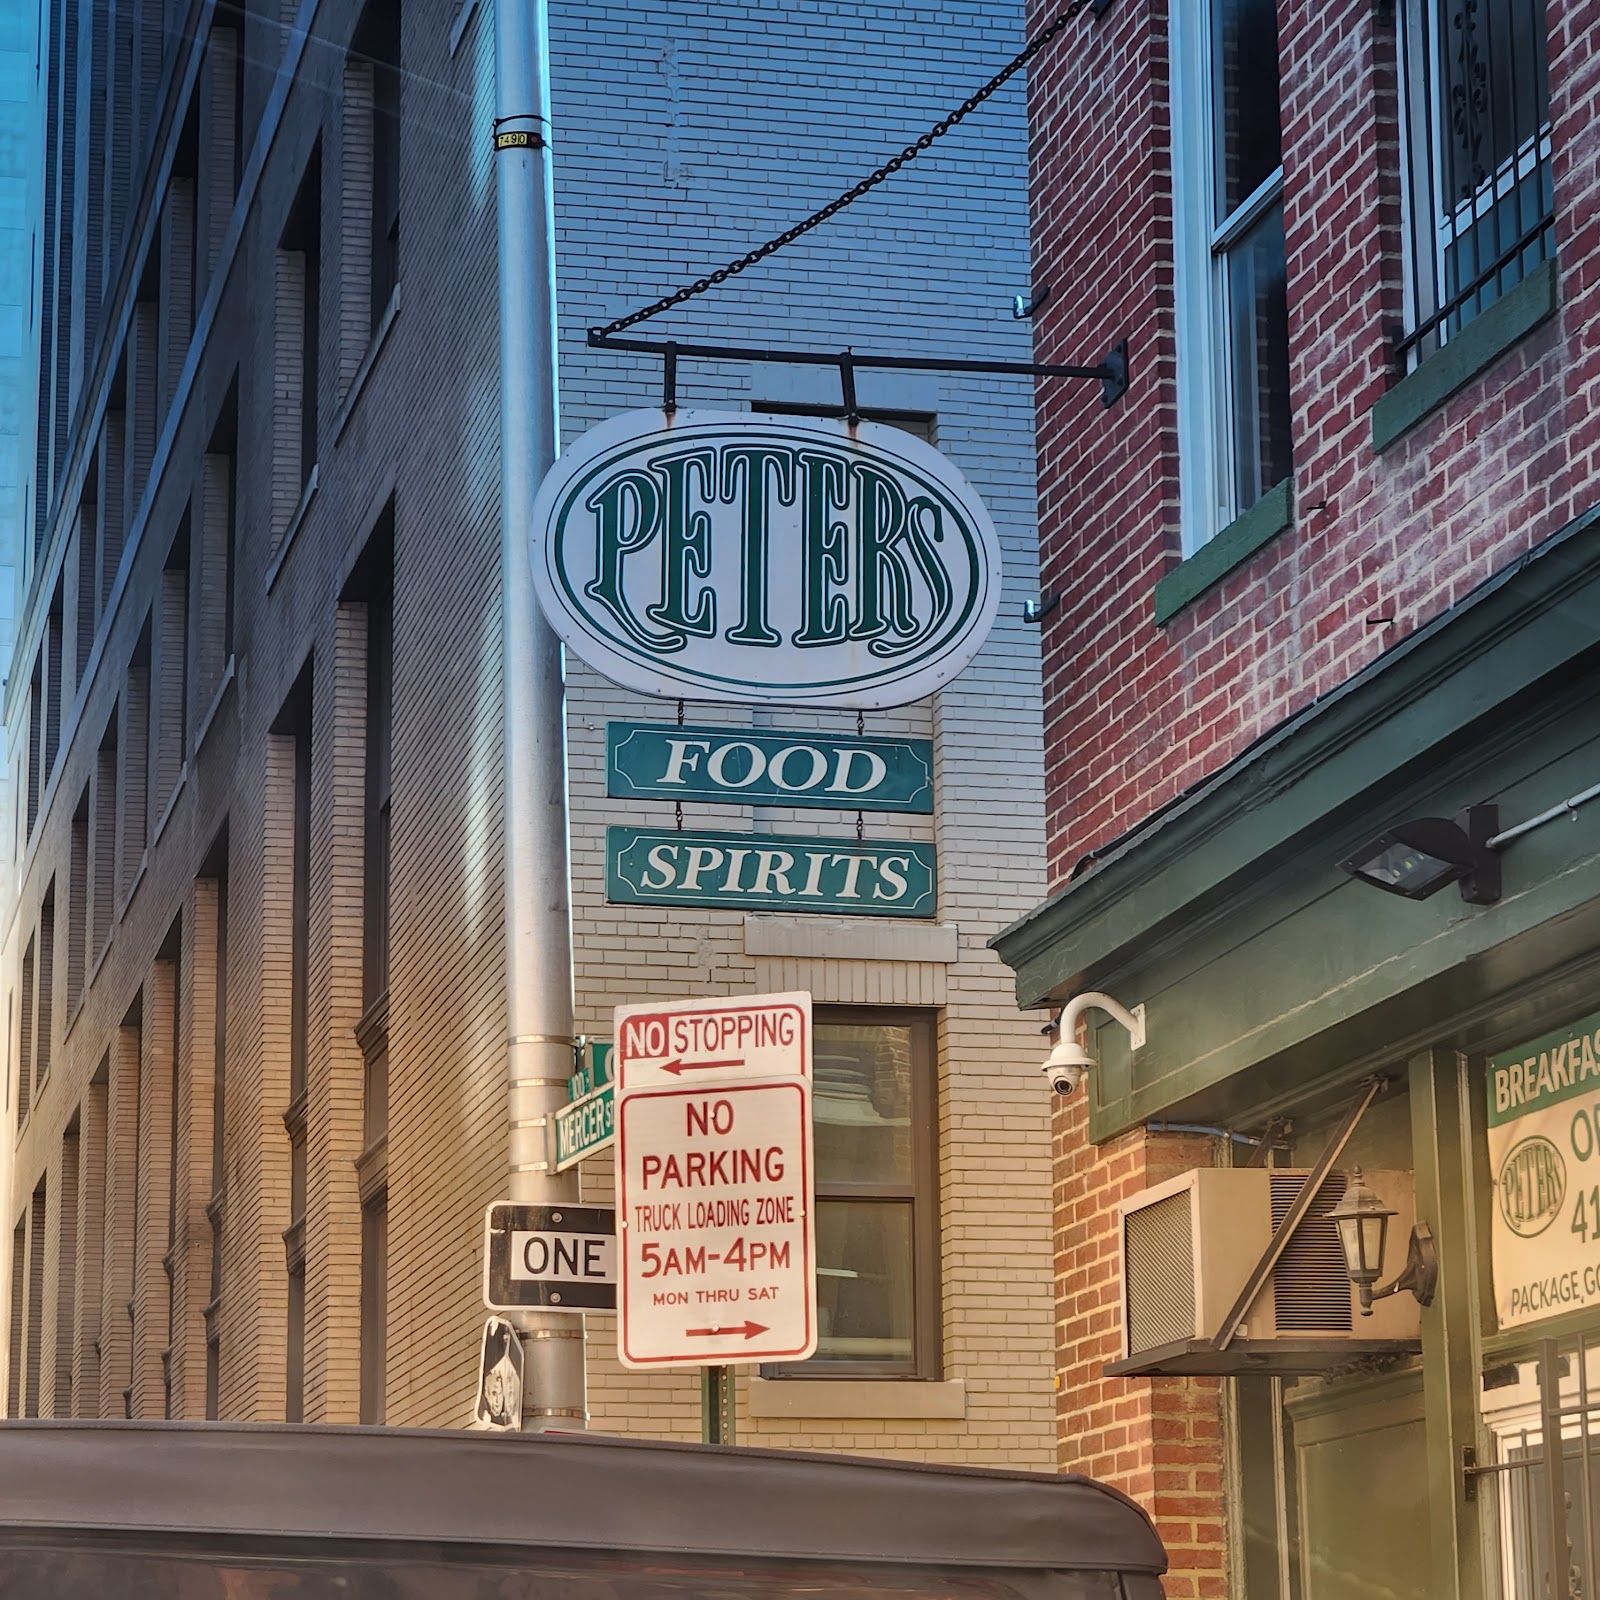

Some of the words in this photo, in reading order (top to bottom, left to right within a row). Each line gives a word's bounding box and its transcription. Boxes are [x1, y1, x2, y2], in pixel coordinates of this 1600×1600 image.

[499, 133, 526, 146] 7490
[584, 445, 954, 658] PETERS
[656, 739, 887, 793] FOOD
[640, 844, 910, 901] SPIRITS
[626, 1021, 665, 1057] NO
[674, 1012, 794, 1054] STOPPING
[571, 1071, 585, 1101] 100
[560, 1097, 605, 1159] MERCER
[686, 1099, 734, 1137] NO
[642, 1146, 784, 1190] PARKING
[1502, 1142, 1562, 1230] PETERS
[635, 1203, 682, 1232] TRUCK
[687, 1199, 750, 1229] LOADING
[756, 1196, 794, 1225] ZONE
[523, 1236, 606, 1278] ONE
[641, 1237, 791, 1278] 5AM-4PM
[653, 1292, 688, 1306] MON
[695, 1288, 740, 1304] THRU
[748, 1286, 779, 1301] SAT
[1511, 1270, 1580, 1317] PACKAGE
[1583, 1263, 1600, 1296] G
